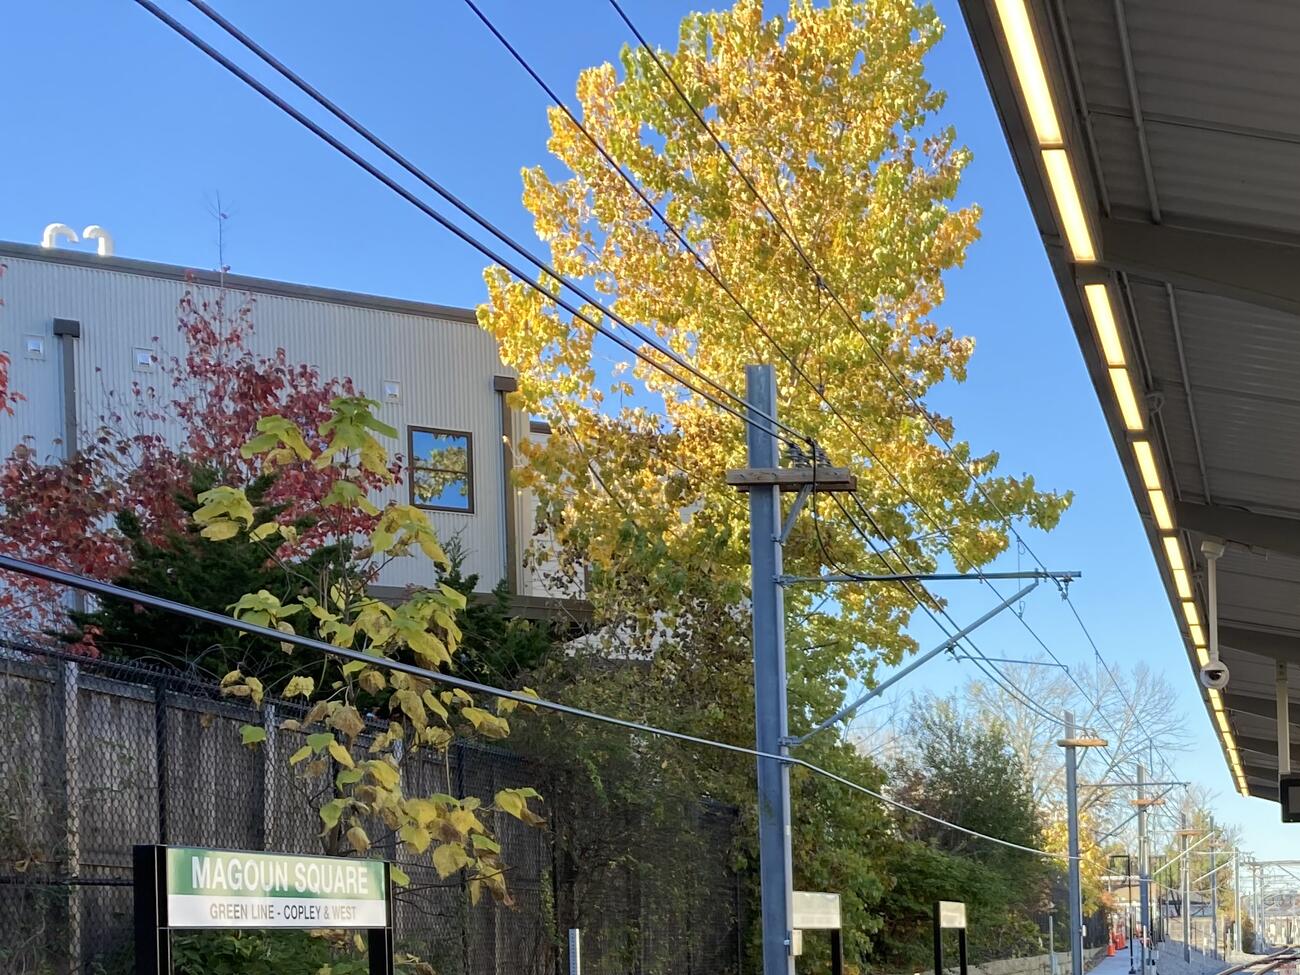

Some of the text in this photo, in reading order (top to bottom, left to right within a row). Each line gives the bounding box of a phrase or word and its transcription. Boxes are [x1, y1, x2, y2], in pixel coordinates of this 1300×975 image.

[191, 856, 369, 895] MAGOUN SQUARE
[210, 903, 248, 920] GREEN
[251, 904, 275, 919] LINE
[283, 904, 321, 920] COPLEY
[324, 905, 330, 919] &
[331, 905, 357, 920] WEST
